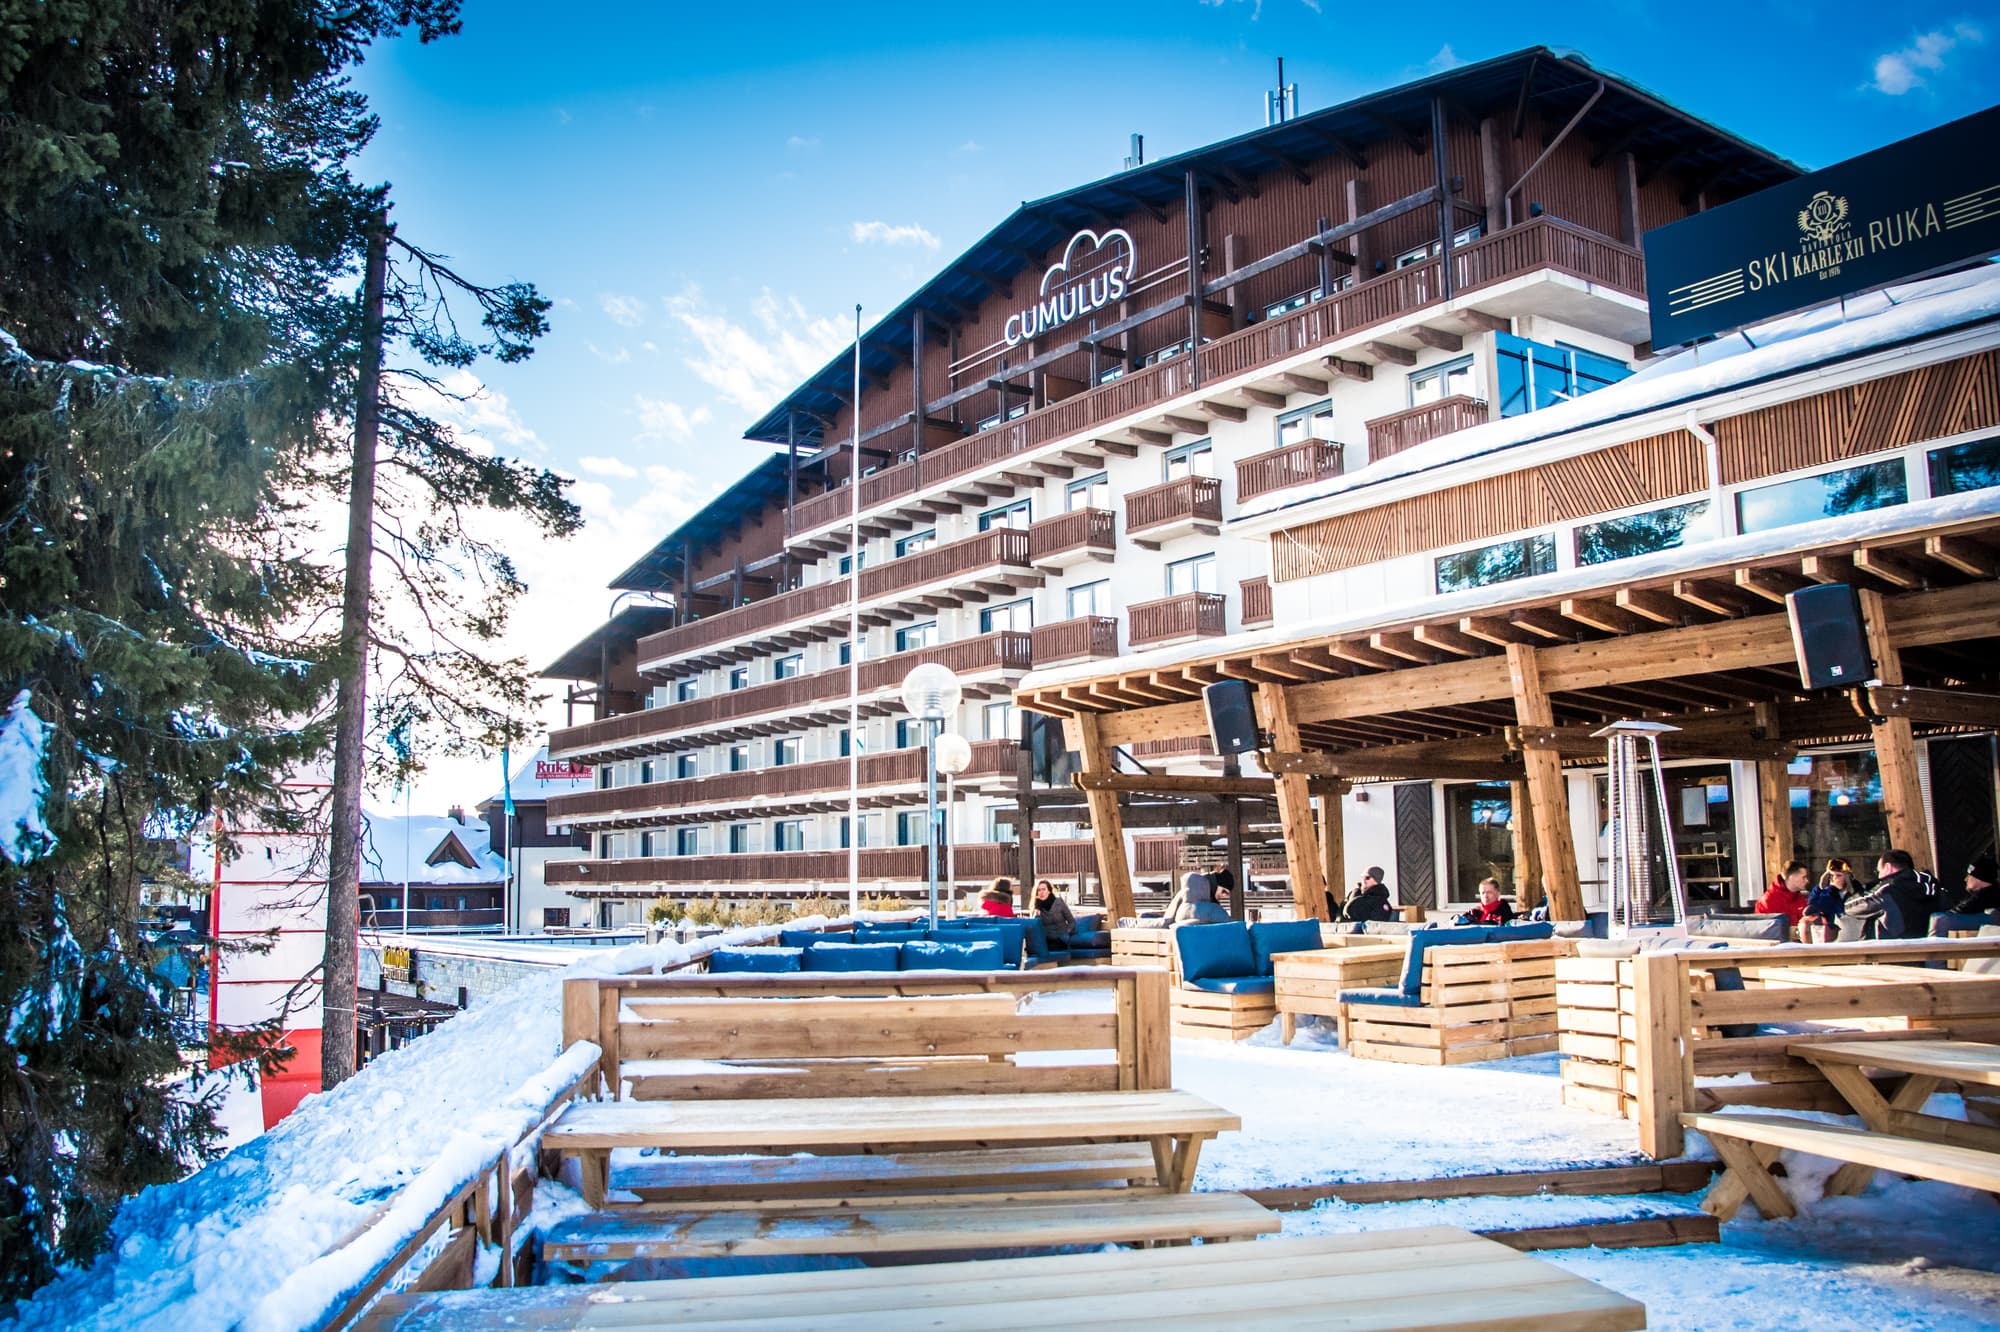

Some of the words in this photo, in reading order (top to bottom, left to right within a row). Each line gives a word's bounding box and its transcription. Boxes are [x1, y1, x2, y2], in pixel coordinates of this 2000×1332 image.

[1748, 251, 1788, 291] SKI
[1791, 244, 1843, 278] KAARLE
[1844, 236, 1865, 262] XII
[1868, 202, 1941, 254] RUKA
[1004, 265, 1124, 346] CUMULUS
